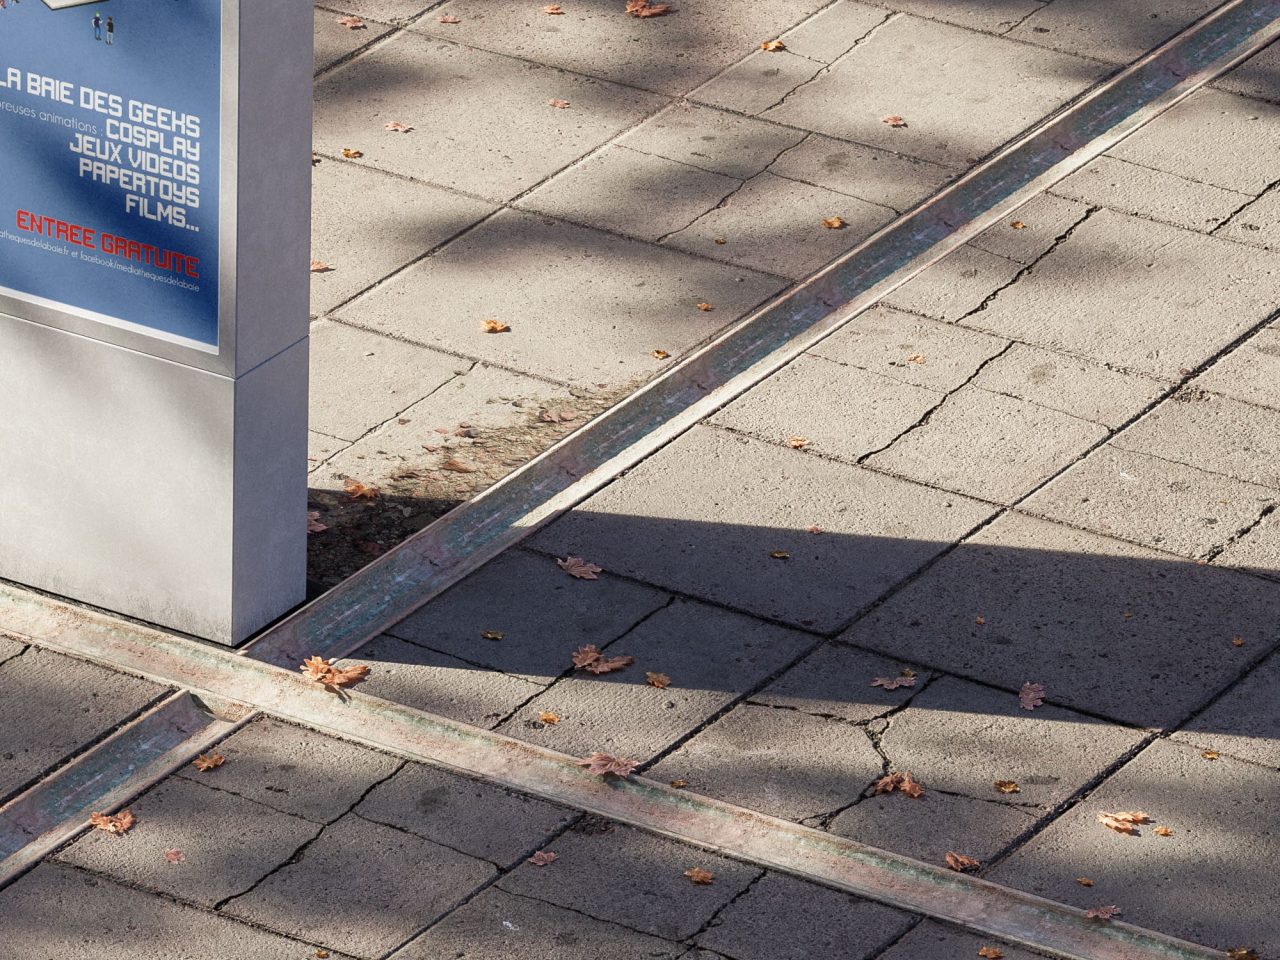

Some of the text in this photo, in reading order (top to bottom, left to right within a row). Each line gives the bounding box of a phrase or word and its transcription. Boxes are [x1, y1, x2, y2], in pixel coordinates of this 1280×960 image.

[27, 72, 74, 105] BAIE
[80, 86, 122, 117] DES
[128, 100, 200, 138] GEEKS
[39, 111, 98, 135] animations
[106, 118, 200, 162] COSPLAY
[69, 132, 200, 185] JEUX VIDEOS
[79, 157, 200, 208] PAPERTOYS
[125, 193, 200, 232] FILMS...
[15, 208, 200, 279] ENTREE GRATUITE
[71, 250, 78, 258] et
